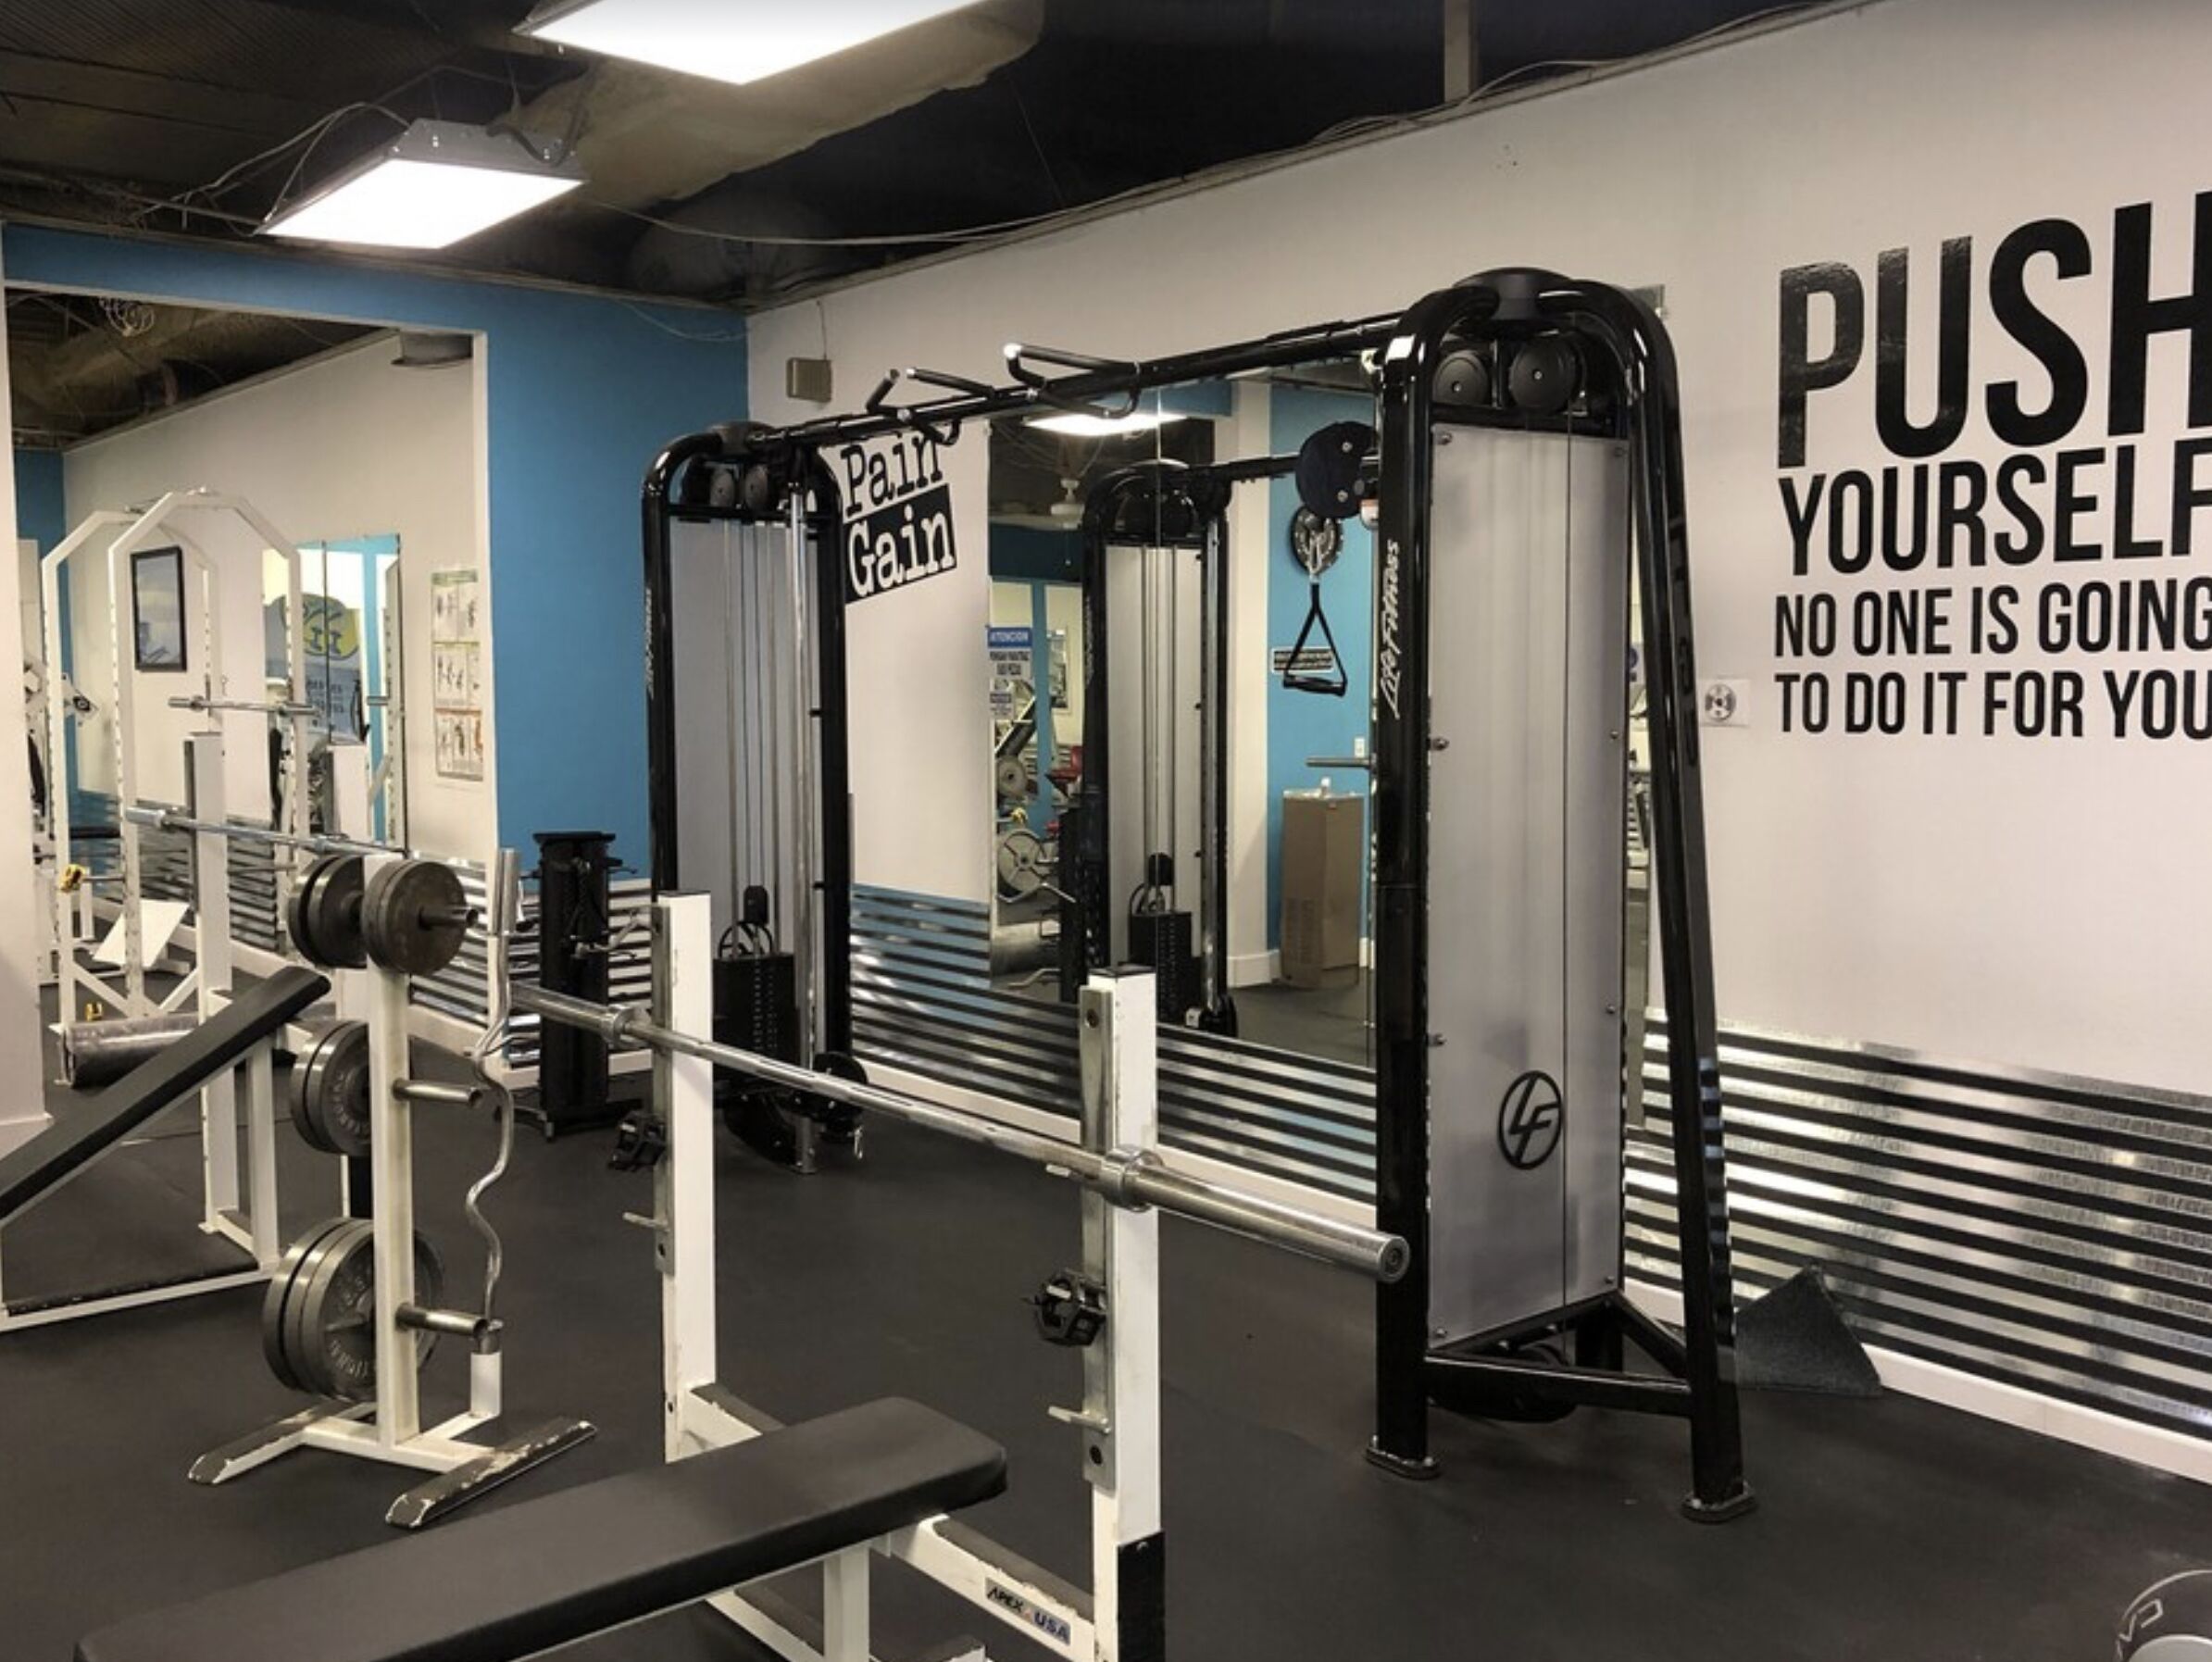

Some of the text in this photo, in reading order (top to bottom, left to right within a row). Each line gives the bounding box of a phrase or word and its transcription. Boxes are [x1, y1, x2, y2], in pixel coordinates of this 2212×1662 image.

[1779, 191, 2212, 469] PUSH
[840, 431, 943, 519] Pain
[1779, 437, 2212, 575] YOURSELF
[849, 504, 955, 596] Gain
[1776, 577, 2212, 656] NO ONE IS GOING
[1775, 670, 2212, 739] TO DO IT FOR YOU
[1033, 1611, 1069, 1645] USA
